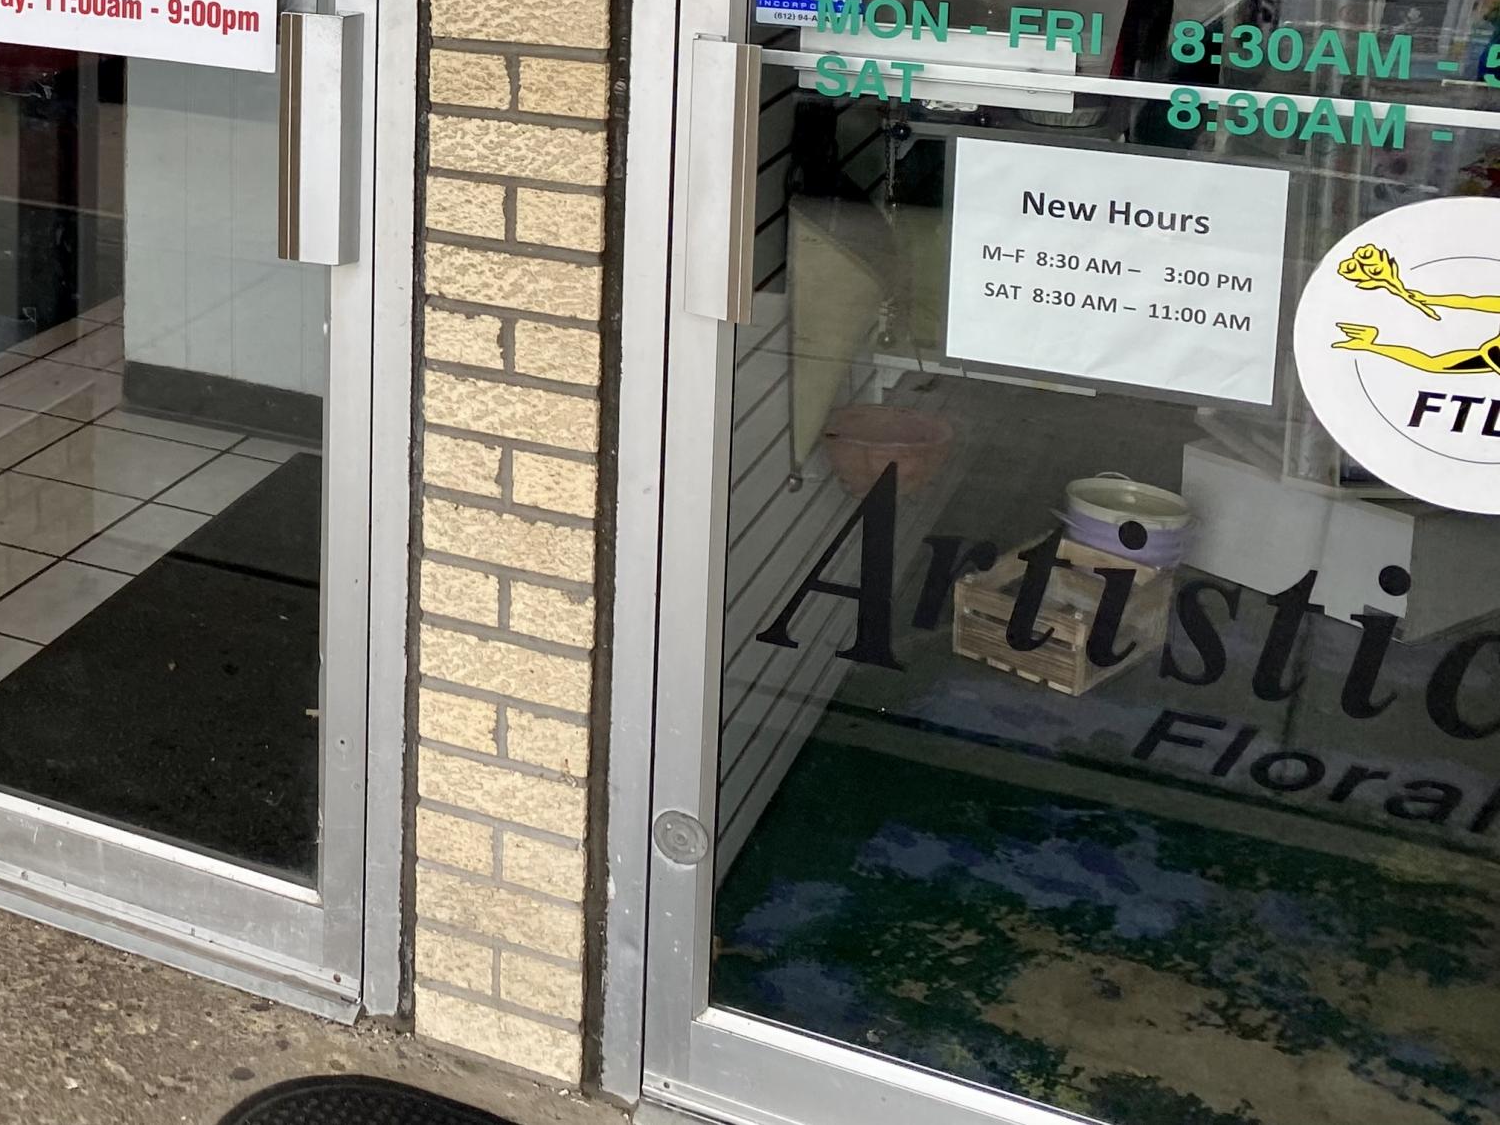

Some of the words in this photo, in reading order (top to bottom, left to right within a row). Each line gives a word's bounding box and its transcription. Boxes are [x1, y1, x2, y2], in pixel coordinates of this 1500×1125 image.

[774, 12, 796, 21] (612)
[1009, 7, 1103, 56] FRI
[1171, 21, 1412, 80] 8:30AM
[815, 54, 926, 103] SAT
[1167, 87, 1408, 149] 8:30AM
[1022, 190, 1097, 222] New
[1109, 200, 1211, 235] Hours
[1036, 250, 1080, 271] 8:30
[1085, 258, 1122, 276] AM
[1164, 266, 1210, 287] 3:00
[1217, 274, 1253, 293] PM
[984, 281, 1022, 300] SAT
[1032, 287, 1076, 307] 8:30
[1081, 294, 1117, 313] AM
[1148, 303, 1207, 325] 11:00
[1212, 312, 1251, 332] AM
[756, 460, 1500, 742] Artistic
